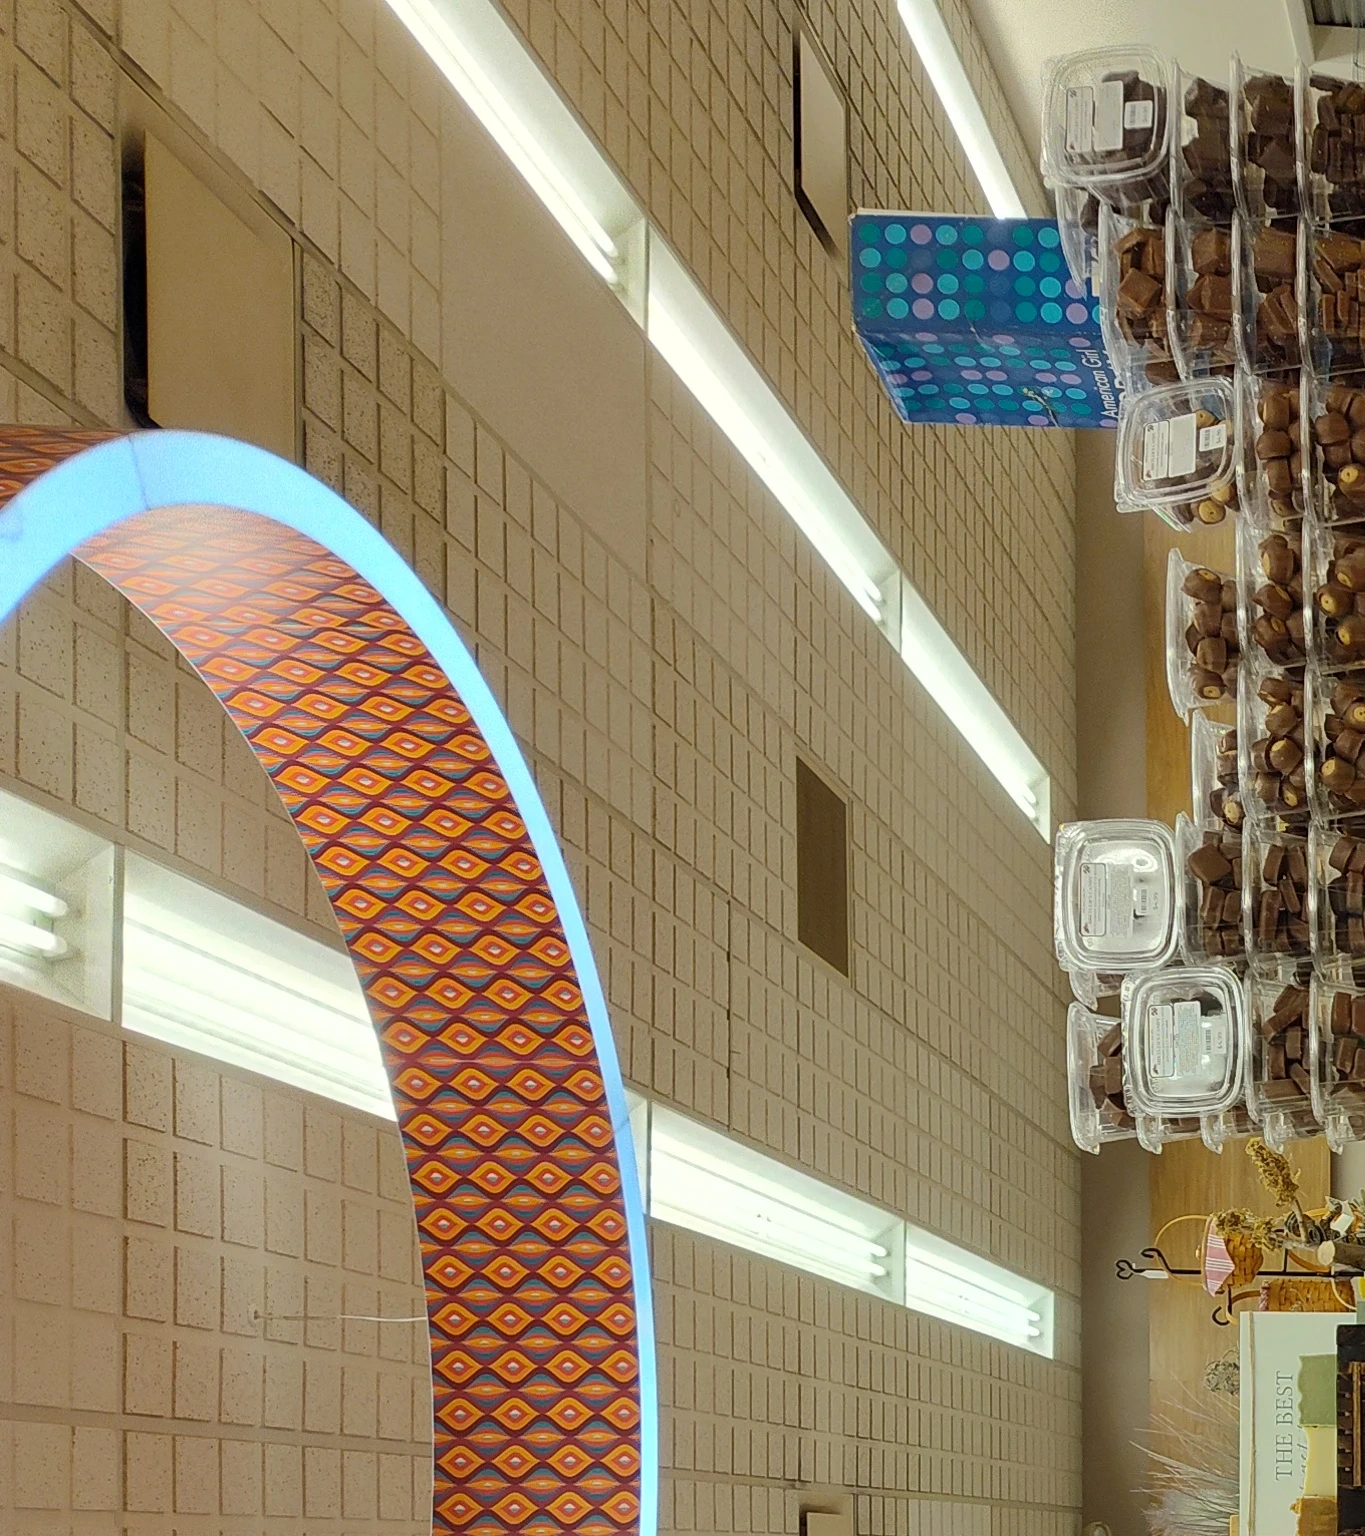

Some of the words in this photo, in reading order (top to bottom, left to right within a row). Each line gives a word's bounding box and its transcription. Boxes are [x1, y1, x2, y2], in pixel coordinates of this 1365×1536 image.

[1076, 349, 1102, 367] Girl
[1094, 371, 1118, 418] American
[1276, 1371, 1293, 1425] BEST
[1276, 1434, 1293, 1480] THE
